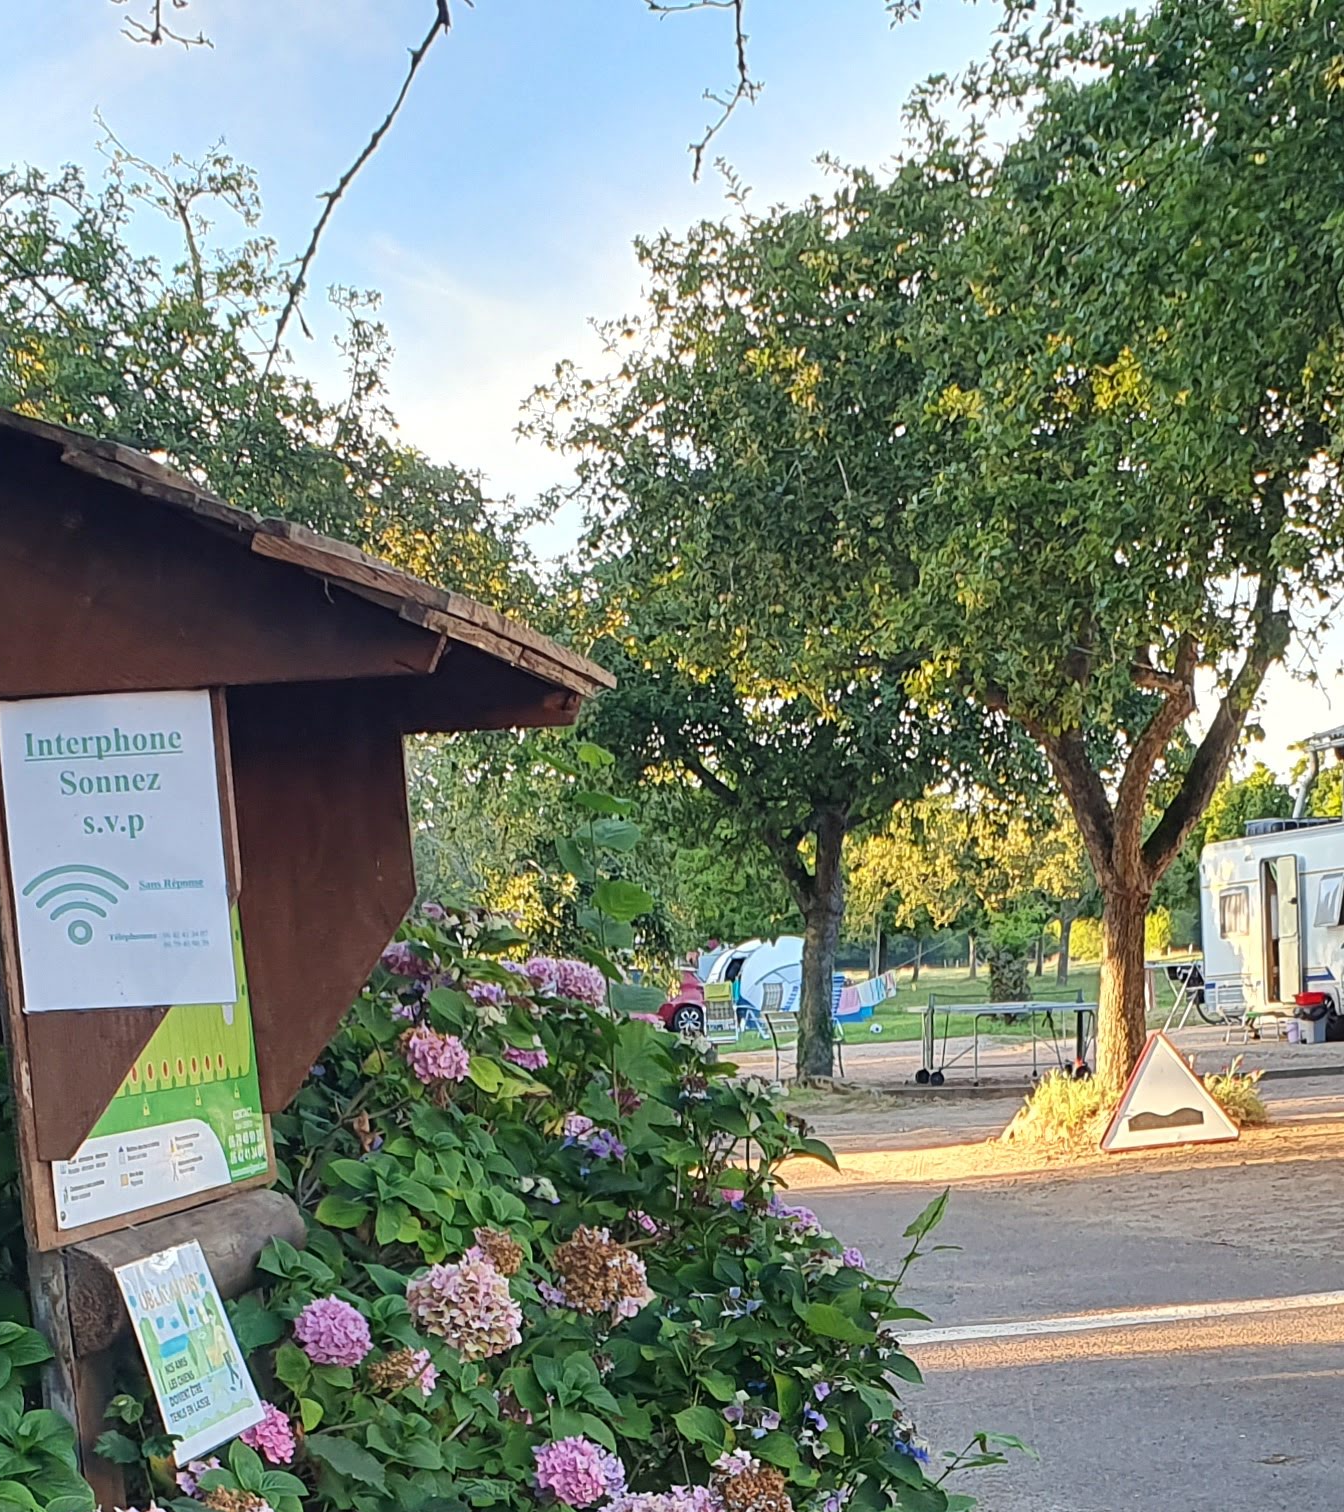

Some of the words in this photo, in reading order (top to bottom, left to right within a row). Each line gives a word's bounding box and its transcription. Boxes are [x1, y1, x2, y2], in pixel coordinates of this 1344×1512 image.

[24, 728, 182, 760] Interphone
[60, 770, 161, 795] Sonnez
[83, 813, 144, 838] s.v.p
